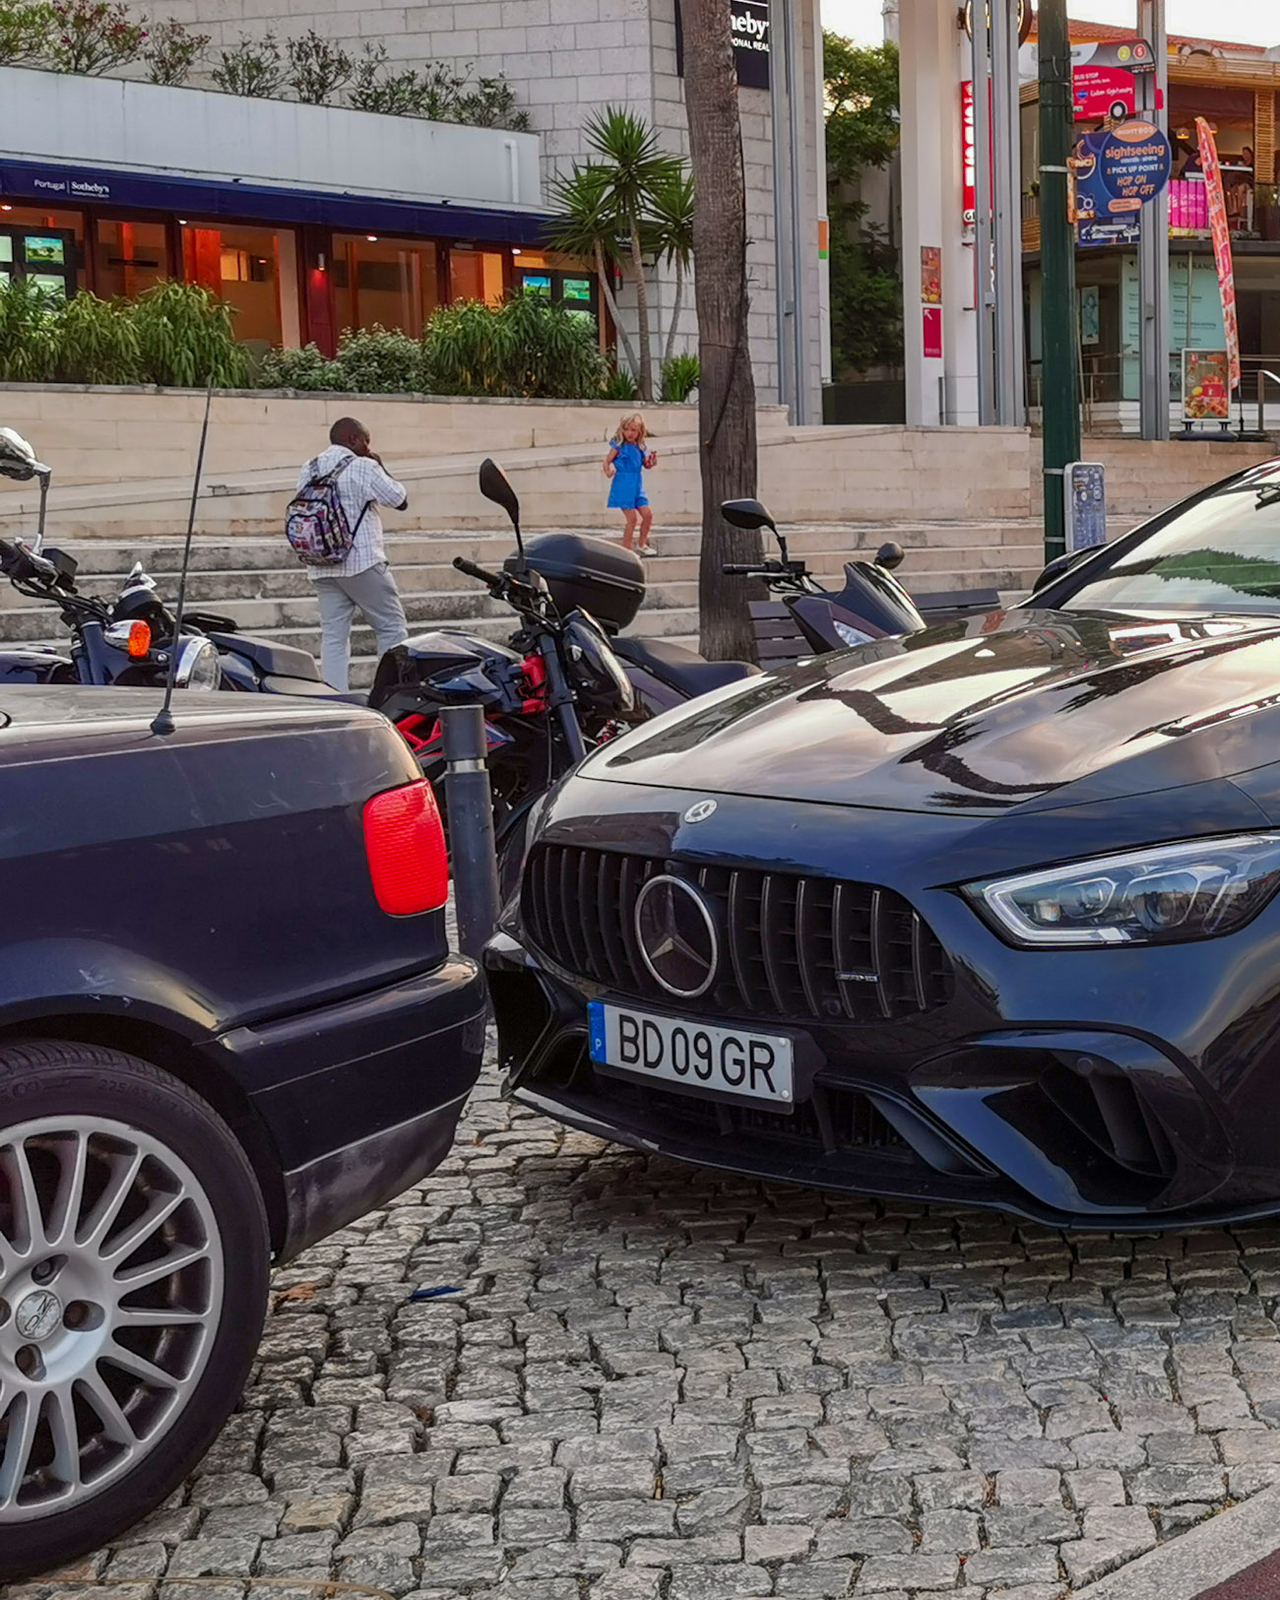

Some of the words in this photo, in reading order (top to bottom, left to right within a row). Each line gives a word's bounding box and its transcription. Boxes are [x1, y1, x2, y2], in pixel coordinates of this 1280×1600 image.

[1086, 72, 1099, 80] STOP
[1105, 143, 1165, 160] sightseeing
[1112, 166, 1127, 174] PICK
[1128, 165, 1138, 173] UP
[1138, 163, 1158, 172] POINT
[34, 179, 65, 191] Portugal
[71, 181, 110, 194] Sotheby's
[1117, 176, 1133, 187] HOP
[1135, 175, 1147, 185] ON
[1122, 186, 1138, 197] HOP
[1140, 184, 1155, 195] OFF
[595, 1038, 602, 1051] P
